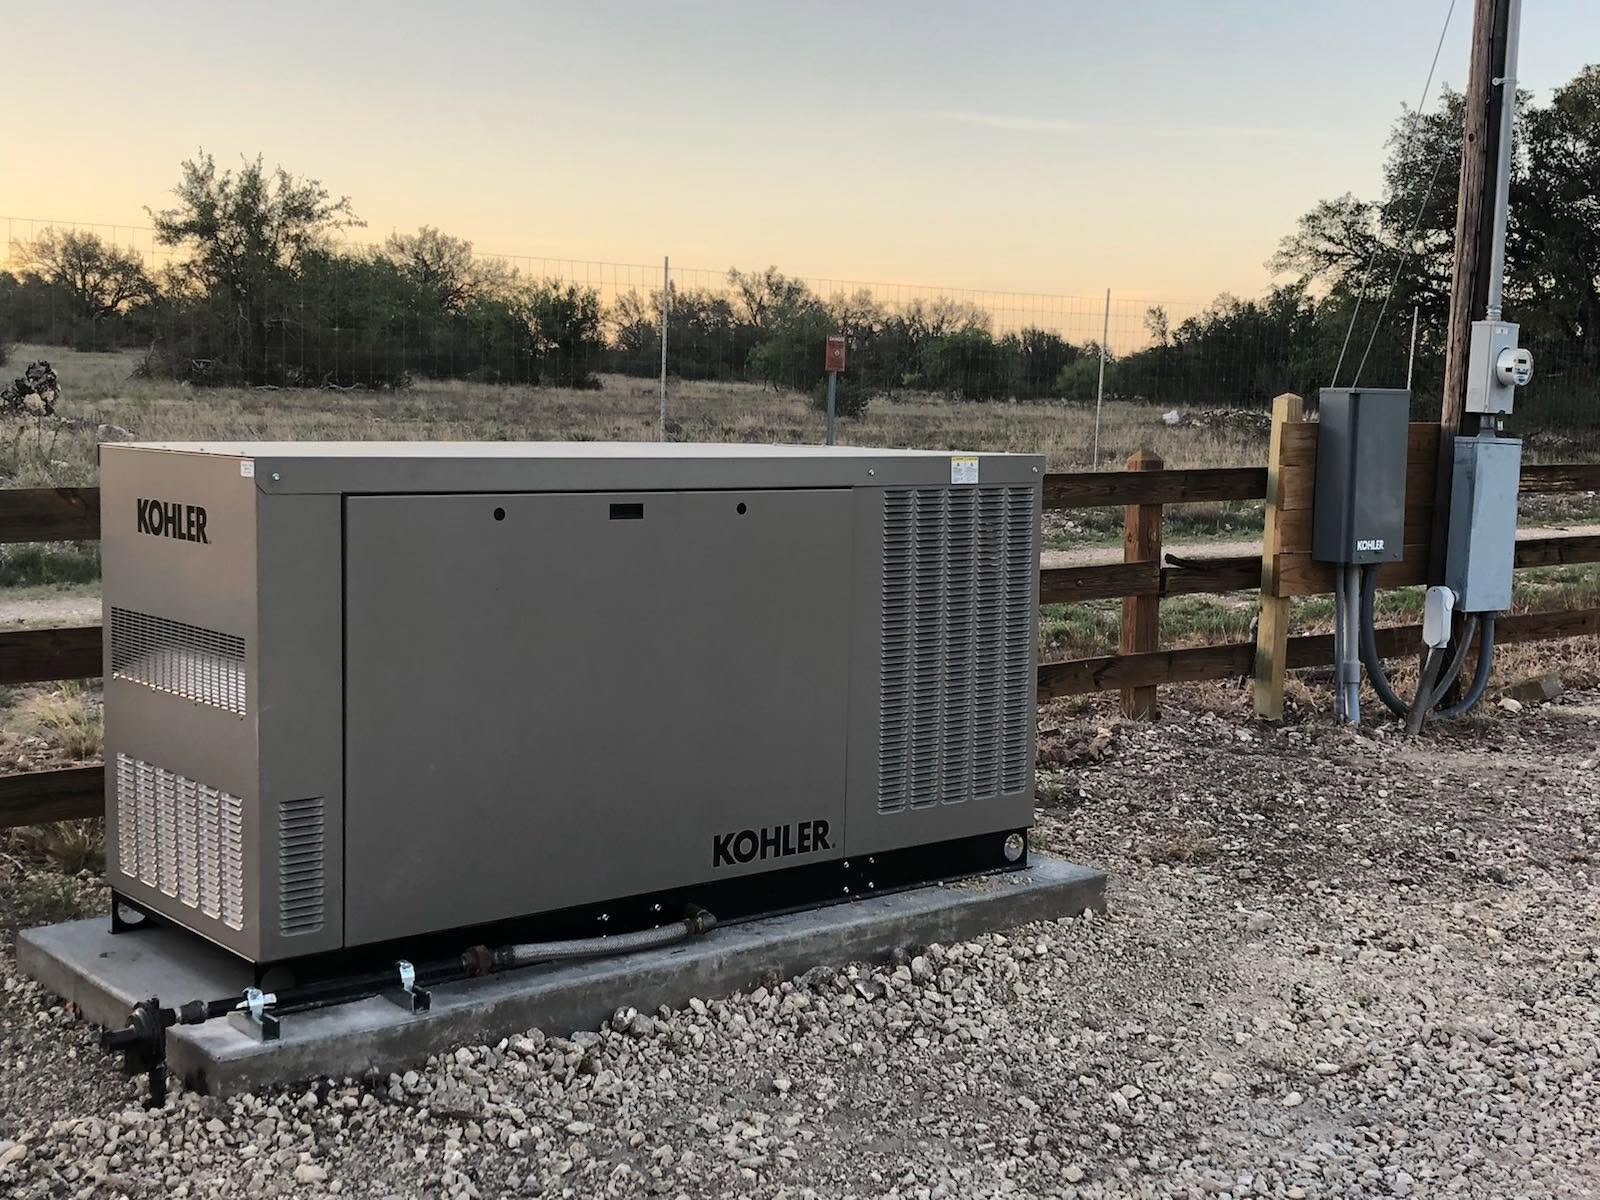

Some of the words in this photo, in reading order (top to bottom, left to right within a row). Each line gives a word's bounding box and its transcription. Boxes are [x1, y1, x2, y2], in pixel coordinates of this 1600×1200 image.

[137, 498, 208, 544] KOHLER
[1357, 539, 1384, 551] KOHLER
[713, 820, 831, 868] KOHLER
